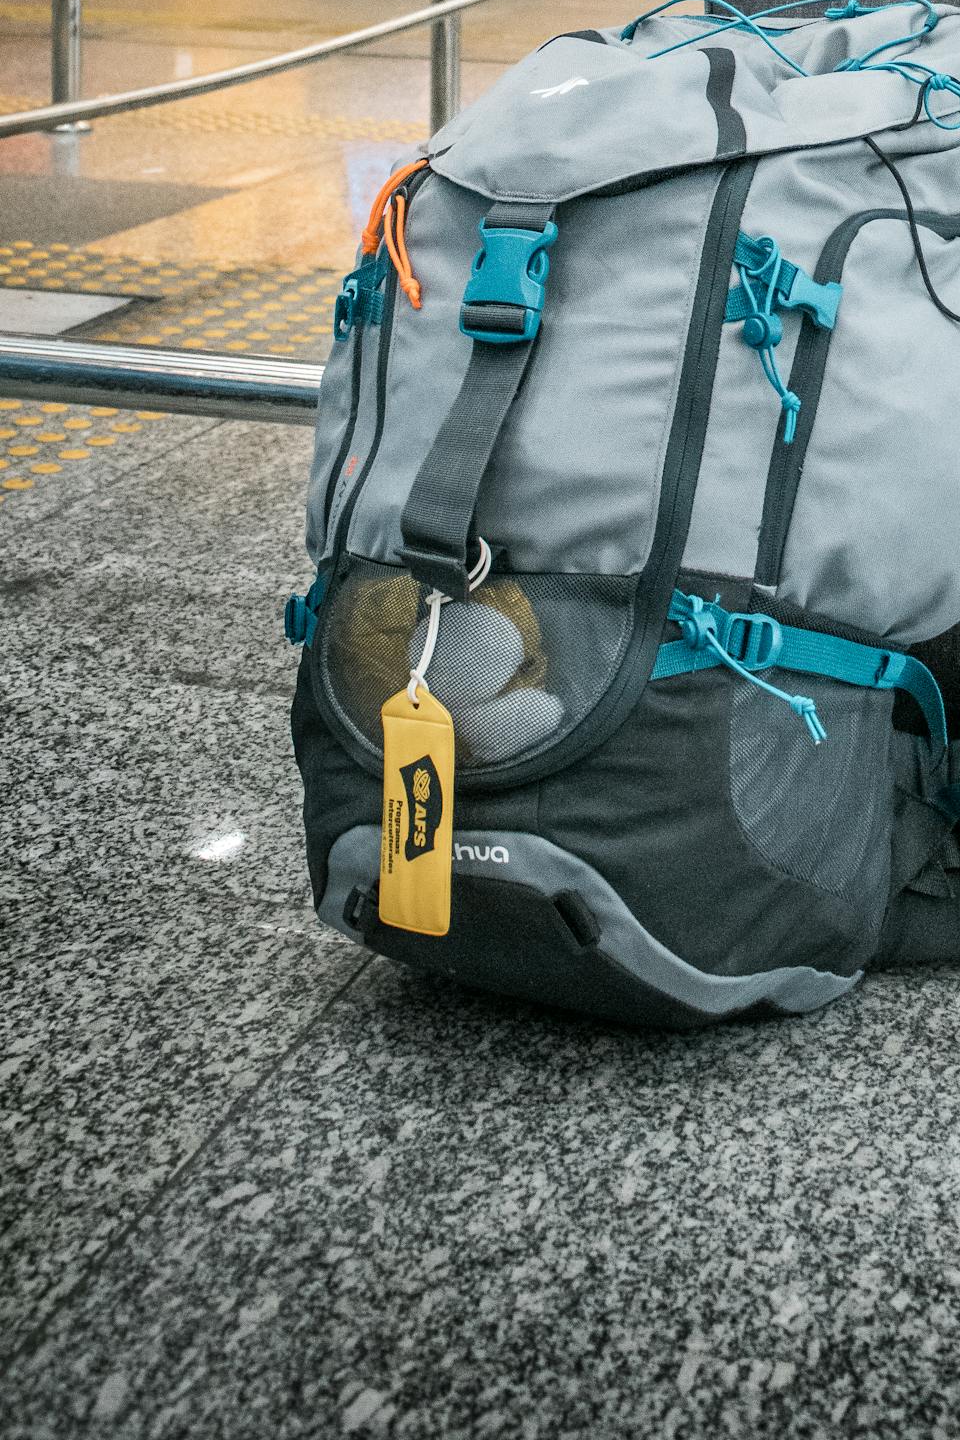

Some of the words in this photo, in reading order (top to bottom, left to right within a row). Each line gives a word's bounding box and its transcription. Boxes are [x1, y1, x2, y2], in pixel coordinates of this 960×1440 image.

[395, 800, 404, 855] Programas
[414, 803, 426, 847] AFS
[452, 843, 509, 863] hua
